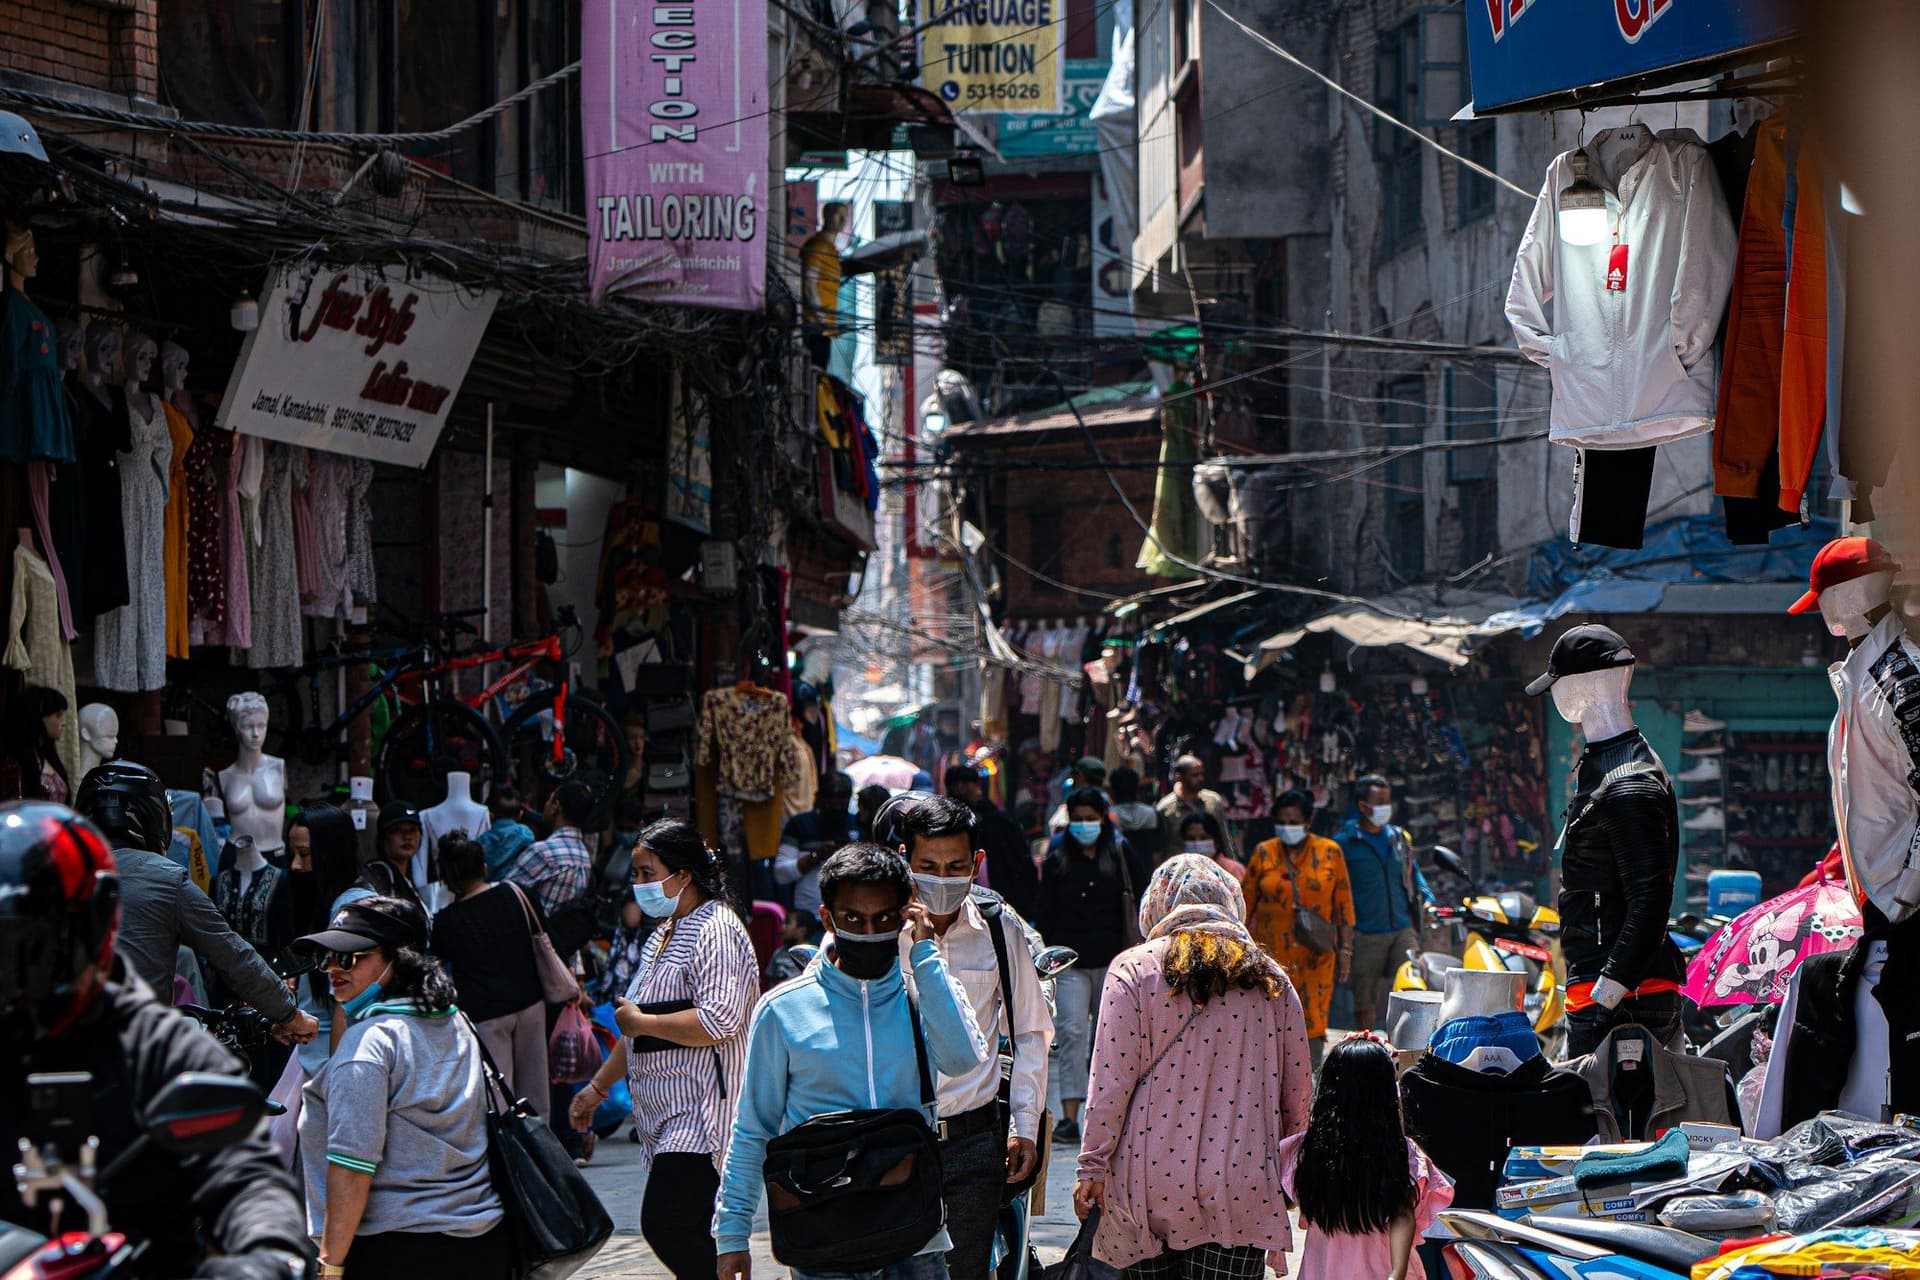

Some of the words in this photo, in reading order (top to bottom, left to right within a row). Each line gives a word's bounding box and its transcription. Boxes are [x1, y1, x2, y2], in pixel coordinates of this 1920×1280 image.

[943, 43, 1036, 74] TUITION
[649, 0, 699, 143] ECTION
[967, 83, 1040, 99] 5315026
[648, 163, 704, 184] WITH
[597, 194, 756, 241] TAILORING
[1483, 1054, 1503, 1063] AAA
[1605, 1200, 1633, 1210] COMFY
[1615, 1212, 1645, 1221] COMFY
